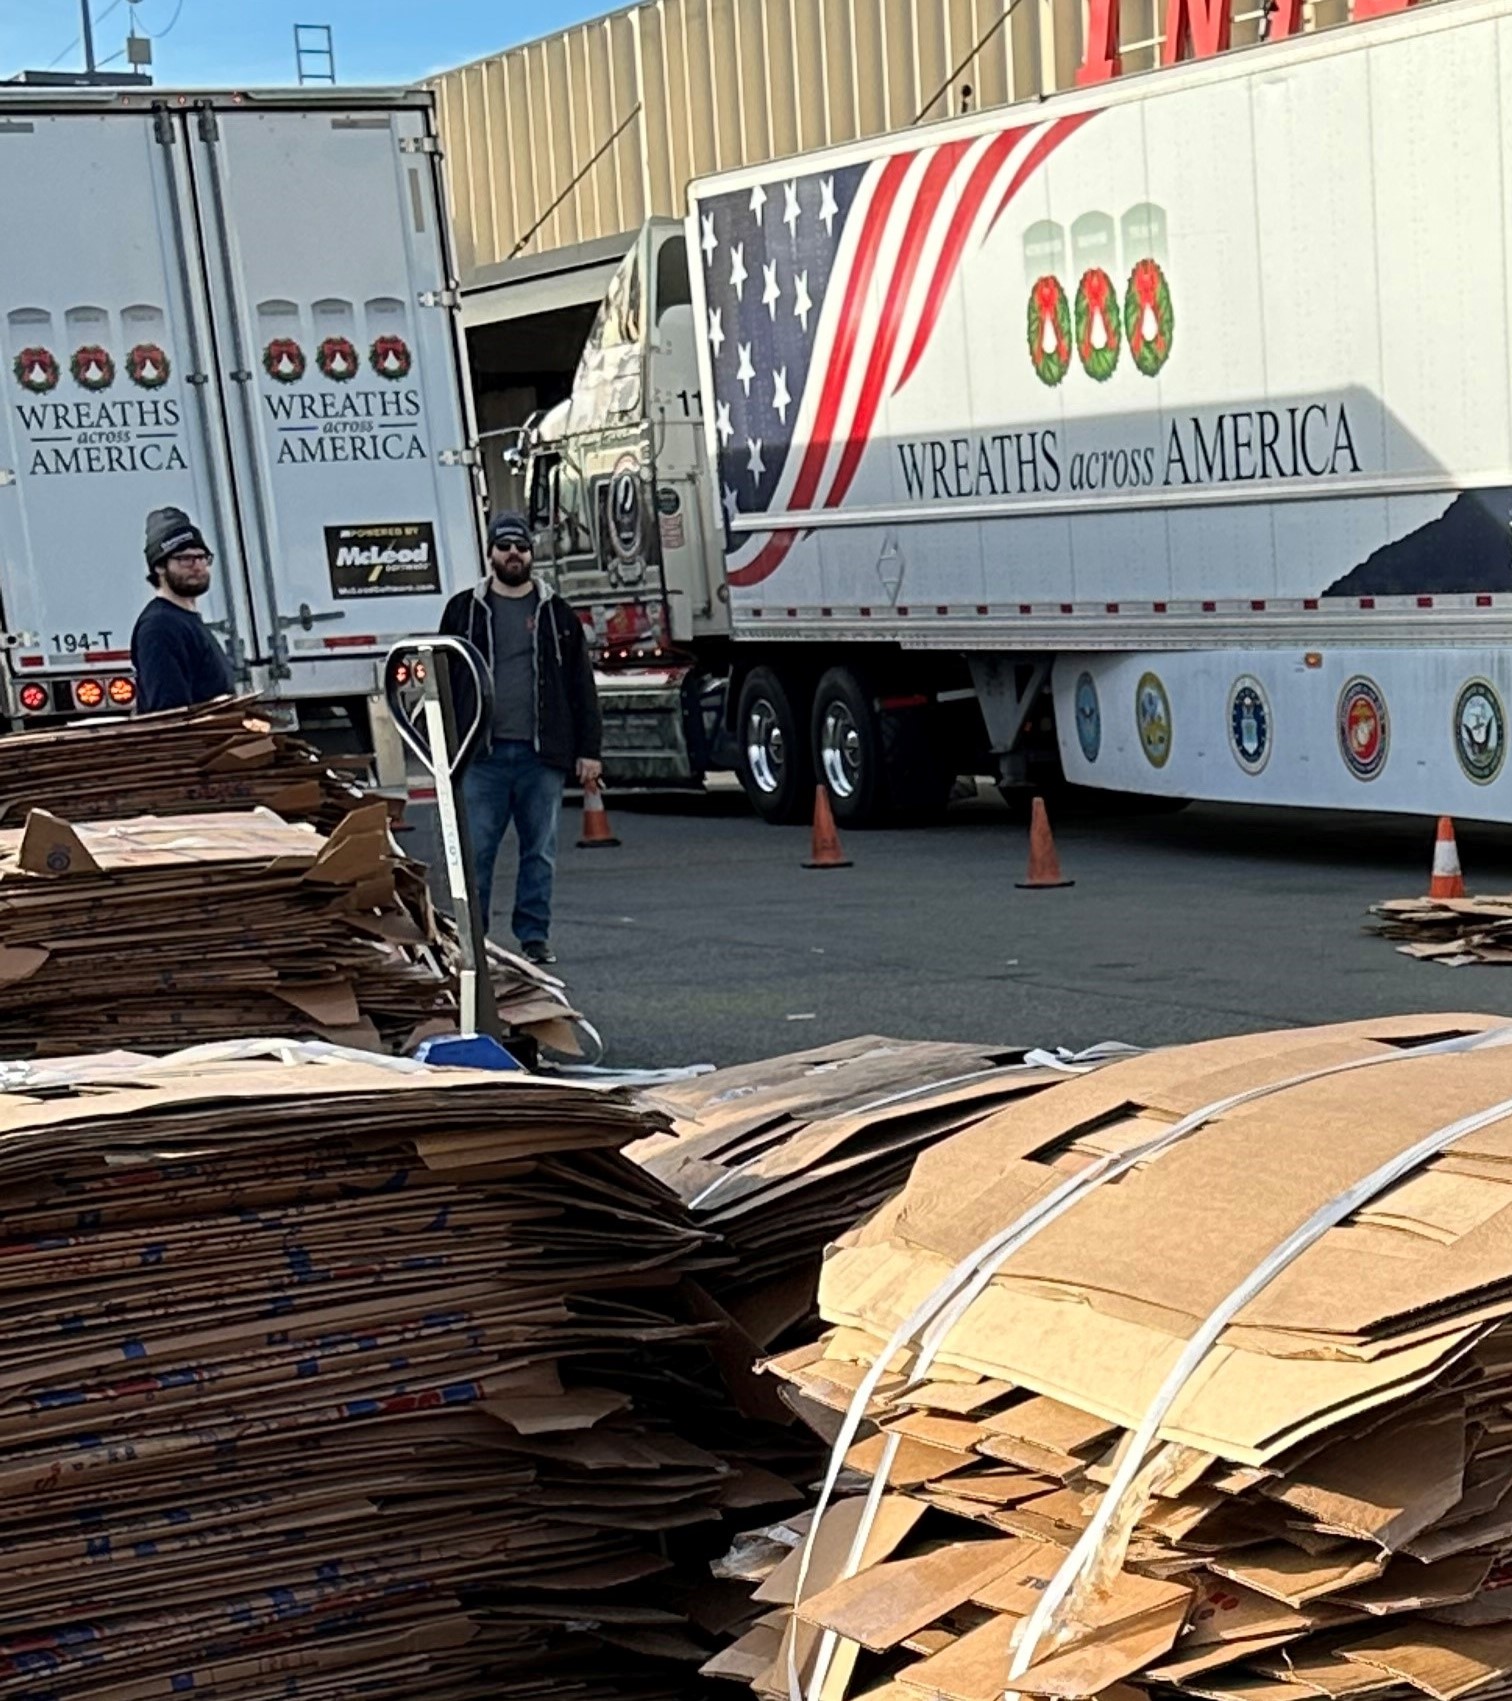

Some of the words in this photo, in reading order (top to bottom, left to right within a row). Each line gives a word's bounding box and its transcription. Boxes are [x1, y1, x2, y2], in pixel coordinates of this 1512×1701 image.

[16, 399, 180, 431] WREATHS
[264, 389, 421, 420] WREATHS
[77, 429, 131, 445] across
[322, 420, 374, 434] across
[30, 444, 188, 475] AMERICA
[277, 433, 427, 464] AMERICA
[897, 430, 1061, 500] WREATHS
[1069, 446, 1156, 492] across
[1162, 402, 1363, 487] AMERICA
[336, 542, 428, 567] McLeod
[52, 631, 113, 653] 194-T
